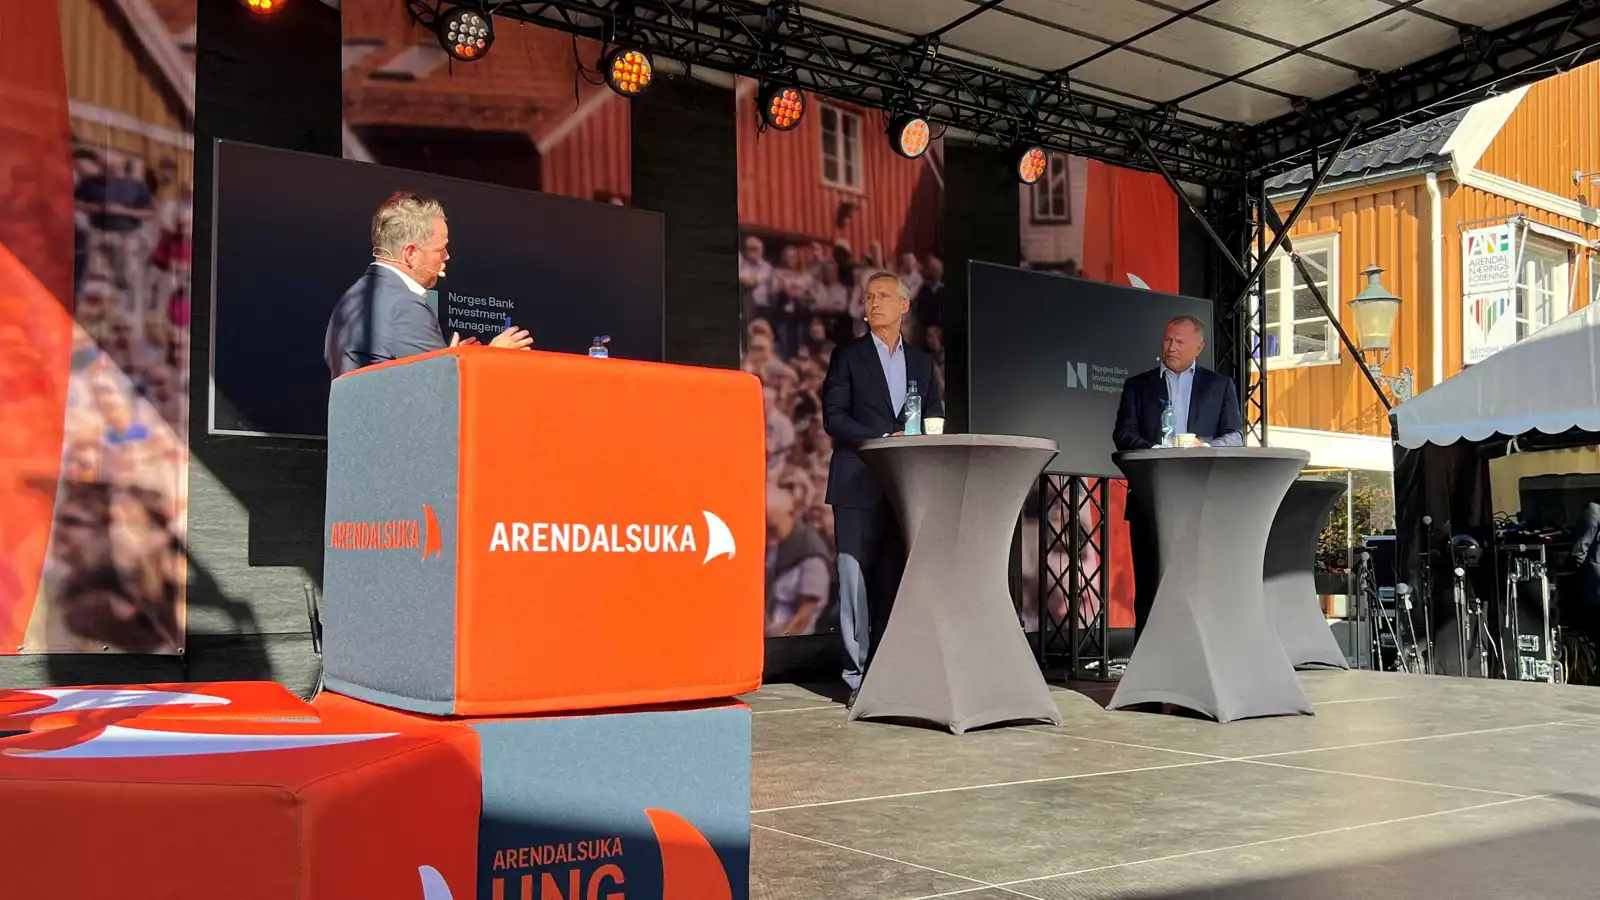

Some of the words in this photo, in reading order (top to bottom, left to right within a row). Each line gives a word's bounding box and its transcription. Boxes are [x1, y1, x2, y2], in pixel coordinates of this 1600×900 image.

[1469, 255, 1507, 266] ARENDAL
[1469, 271, 1509, 282] FORENING
[448, 292, 487, 306] Norges
[488, 297, 515, 309] Bank
[448, 305, 507, 320] Investment
[448, 318, 506, 333] Manageme
[1092, 364, 1114, 375] Norges
[1114, 367, 1129, 375] Bank
[330, 520, 420, 551] ARENDALSUKA
[489, 521, 697, 554] ARENDALSUKA
[492, 837, 624, 871] ARENDALSUKA
